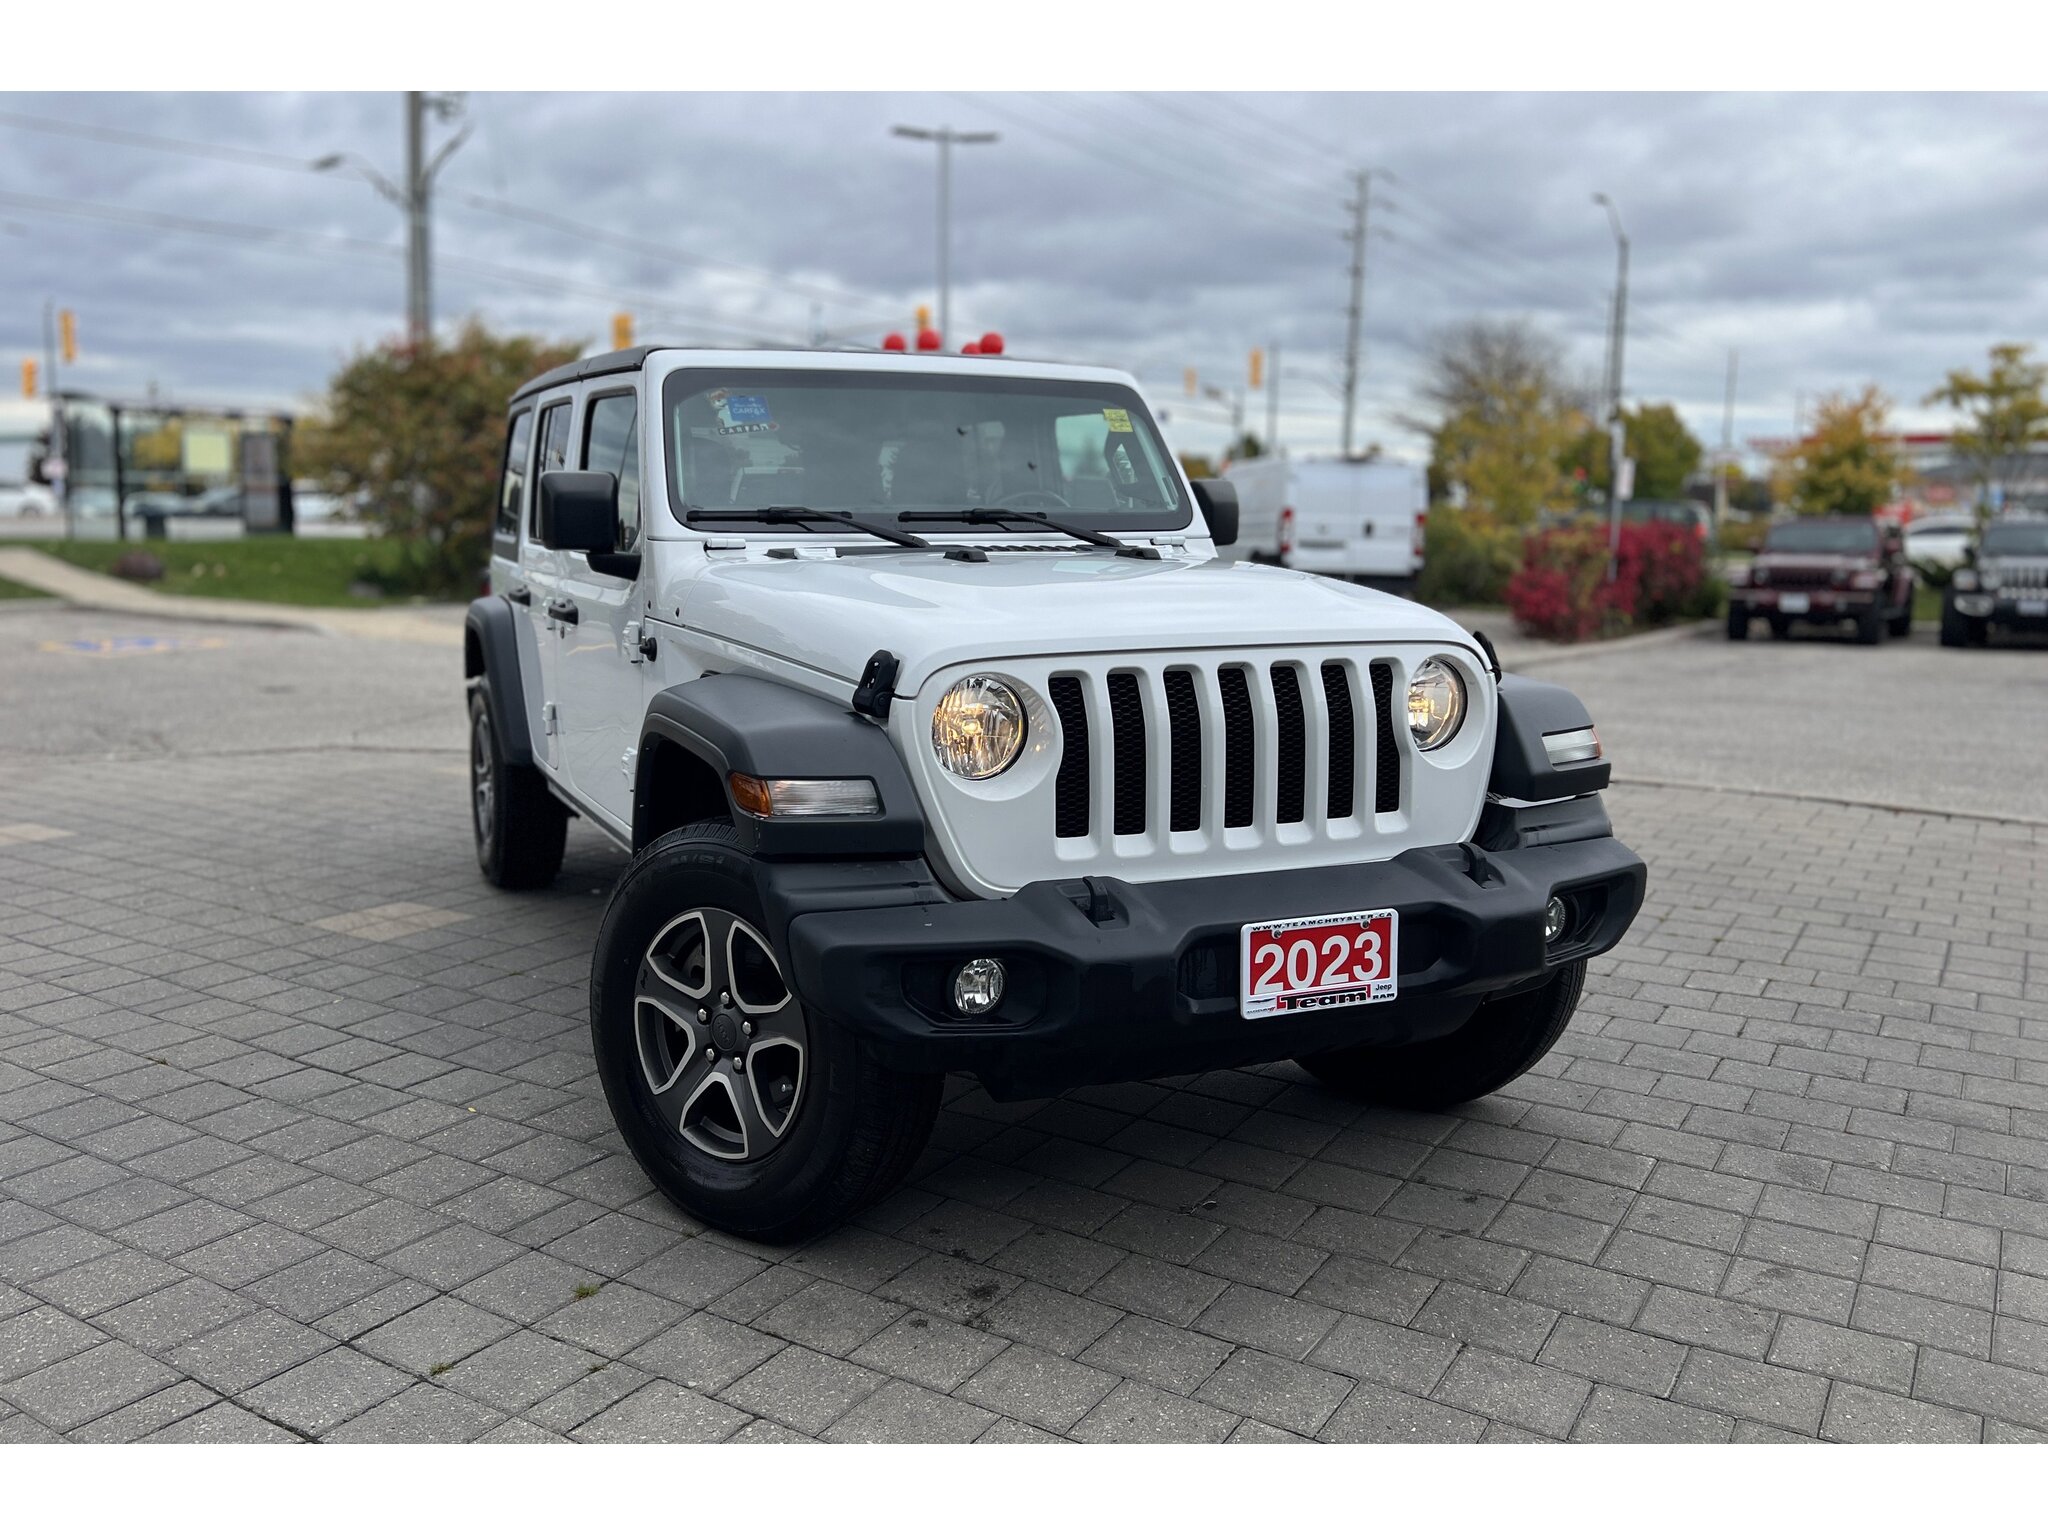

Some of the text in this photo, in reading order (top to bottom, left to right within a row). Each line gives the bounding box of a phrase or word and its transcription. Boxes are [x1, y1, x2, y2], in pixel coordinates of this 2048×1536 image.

[1252, 912, 1393, 931] WWW.TEAMCHRYSLER.CA
[1254, 931, 1383, 995] 2023
[1375, 983, 1393, 991] Jeep
[1280, 987, 1367, 1010] Team
